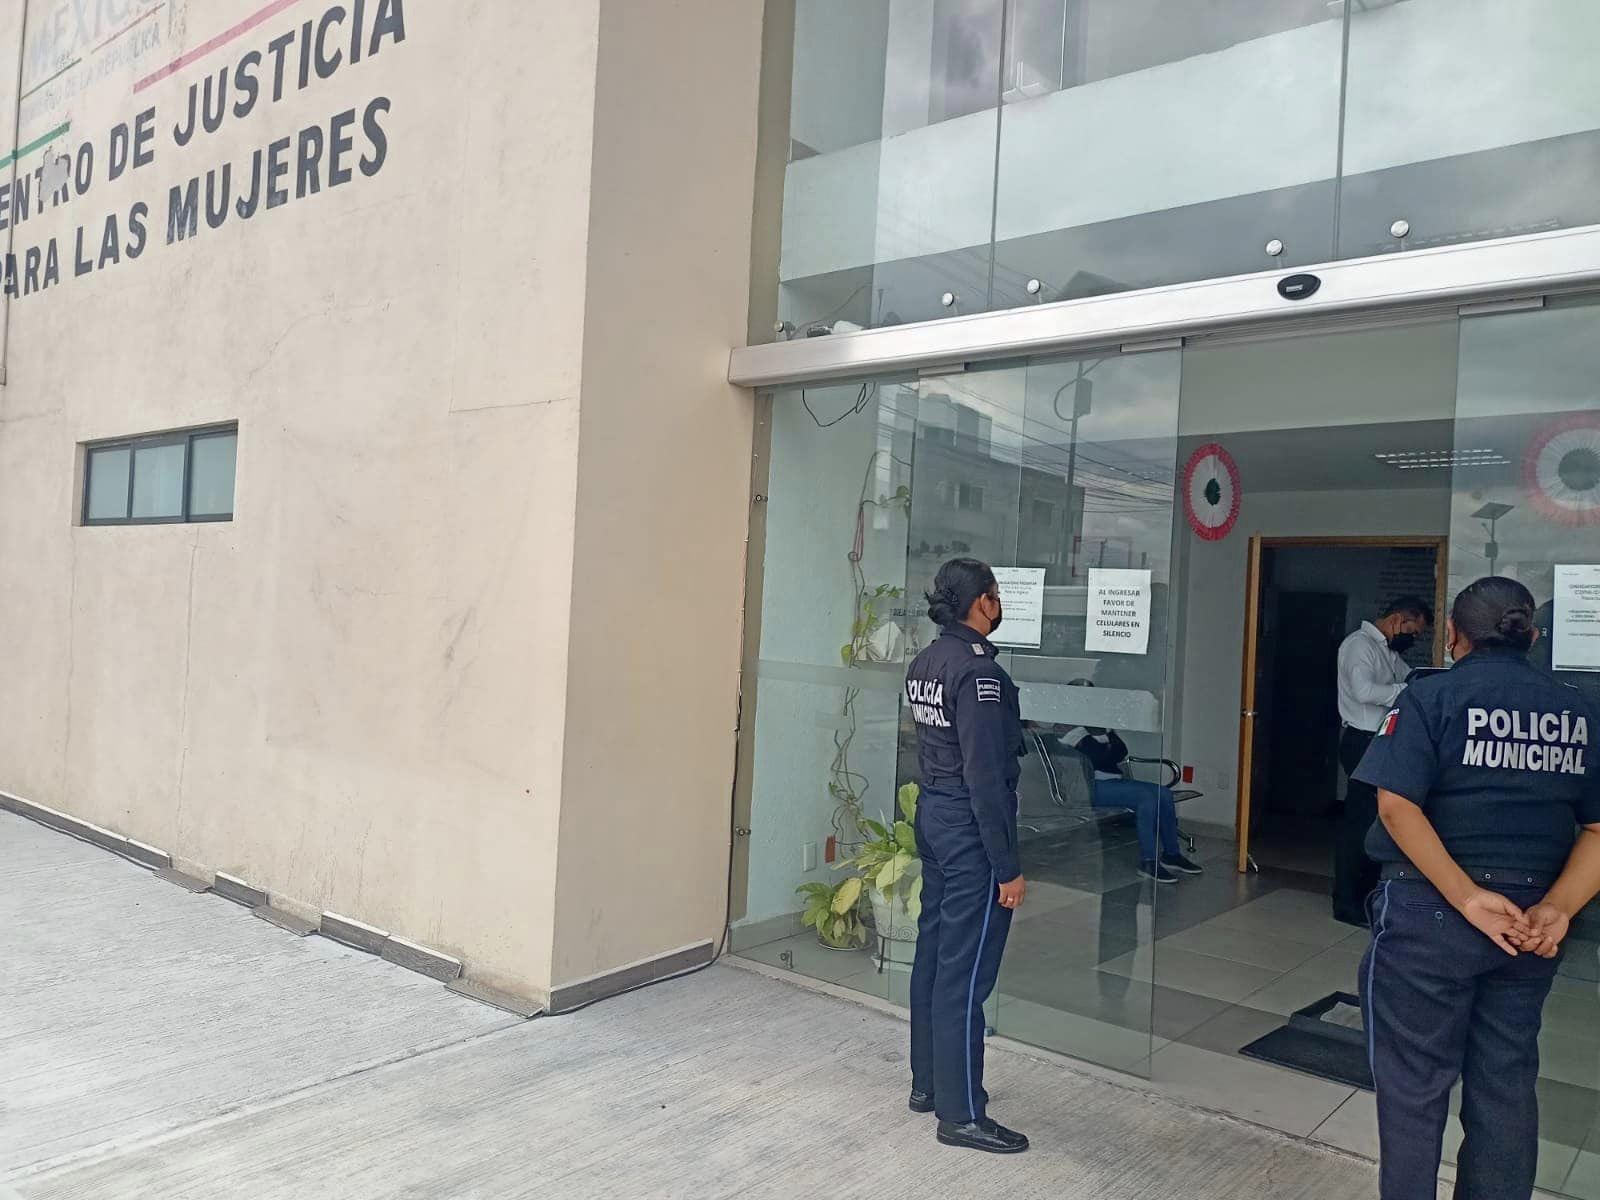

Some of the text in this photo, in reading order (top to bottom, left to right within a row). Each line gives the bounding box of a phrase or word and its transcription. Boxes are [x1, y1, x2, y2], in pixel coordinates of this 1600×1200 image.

[109, 106, 155, 181] DE
[173, 0, 406, 147] JUSTICIA
[0, 96, 391, 299] ARA LAS MUJERES
[1096, 619, 1130, 628] CELULARES
[1101, 609, 1137, 617] MANTENER
[1103, 630, 1132, 638] SILENCIO
[1467, 707, 1589, 745] POLICÍA
[1461, 739, 1587, 775] MUNICIPAL
